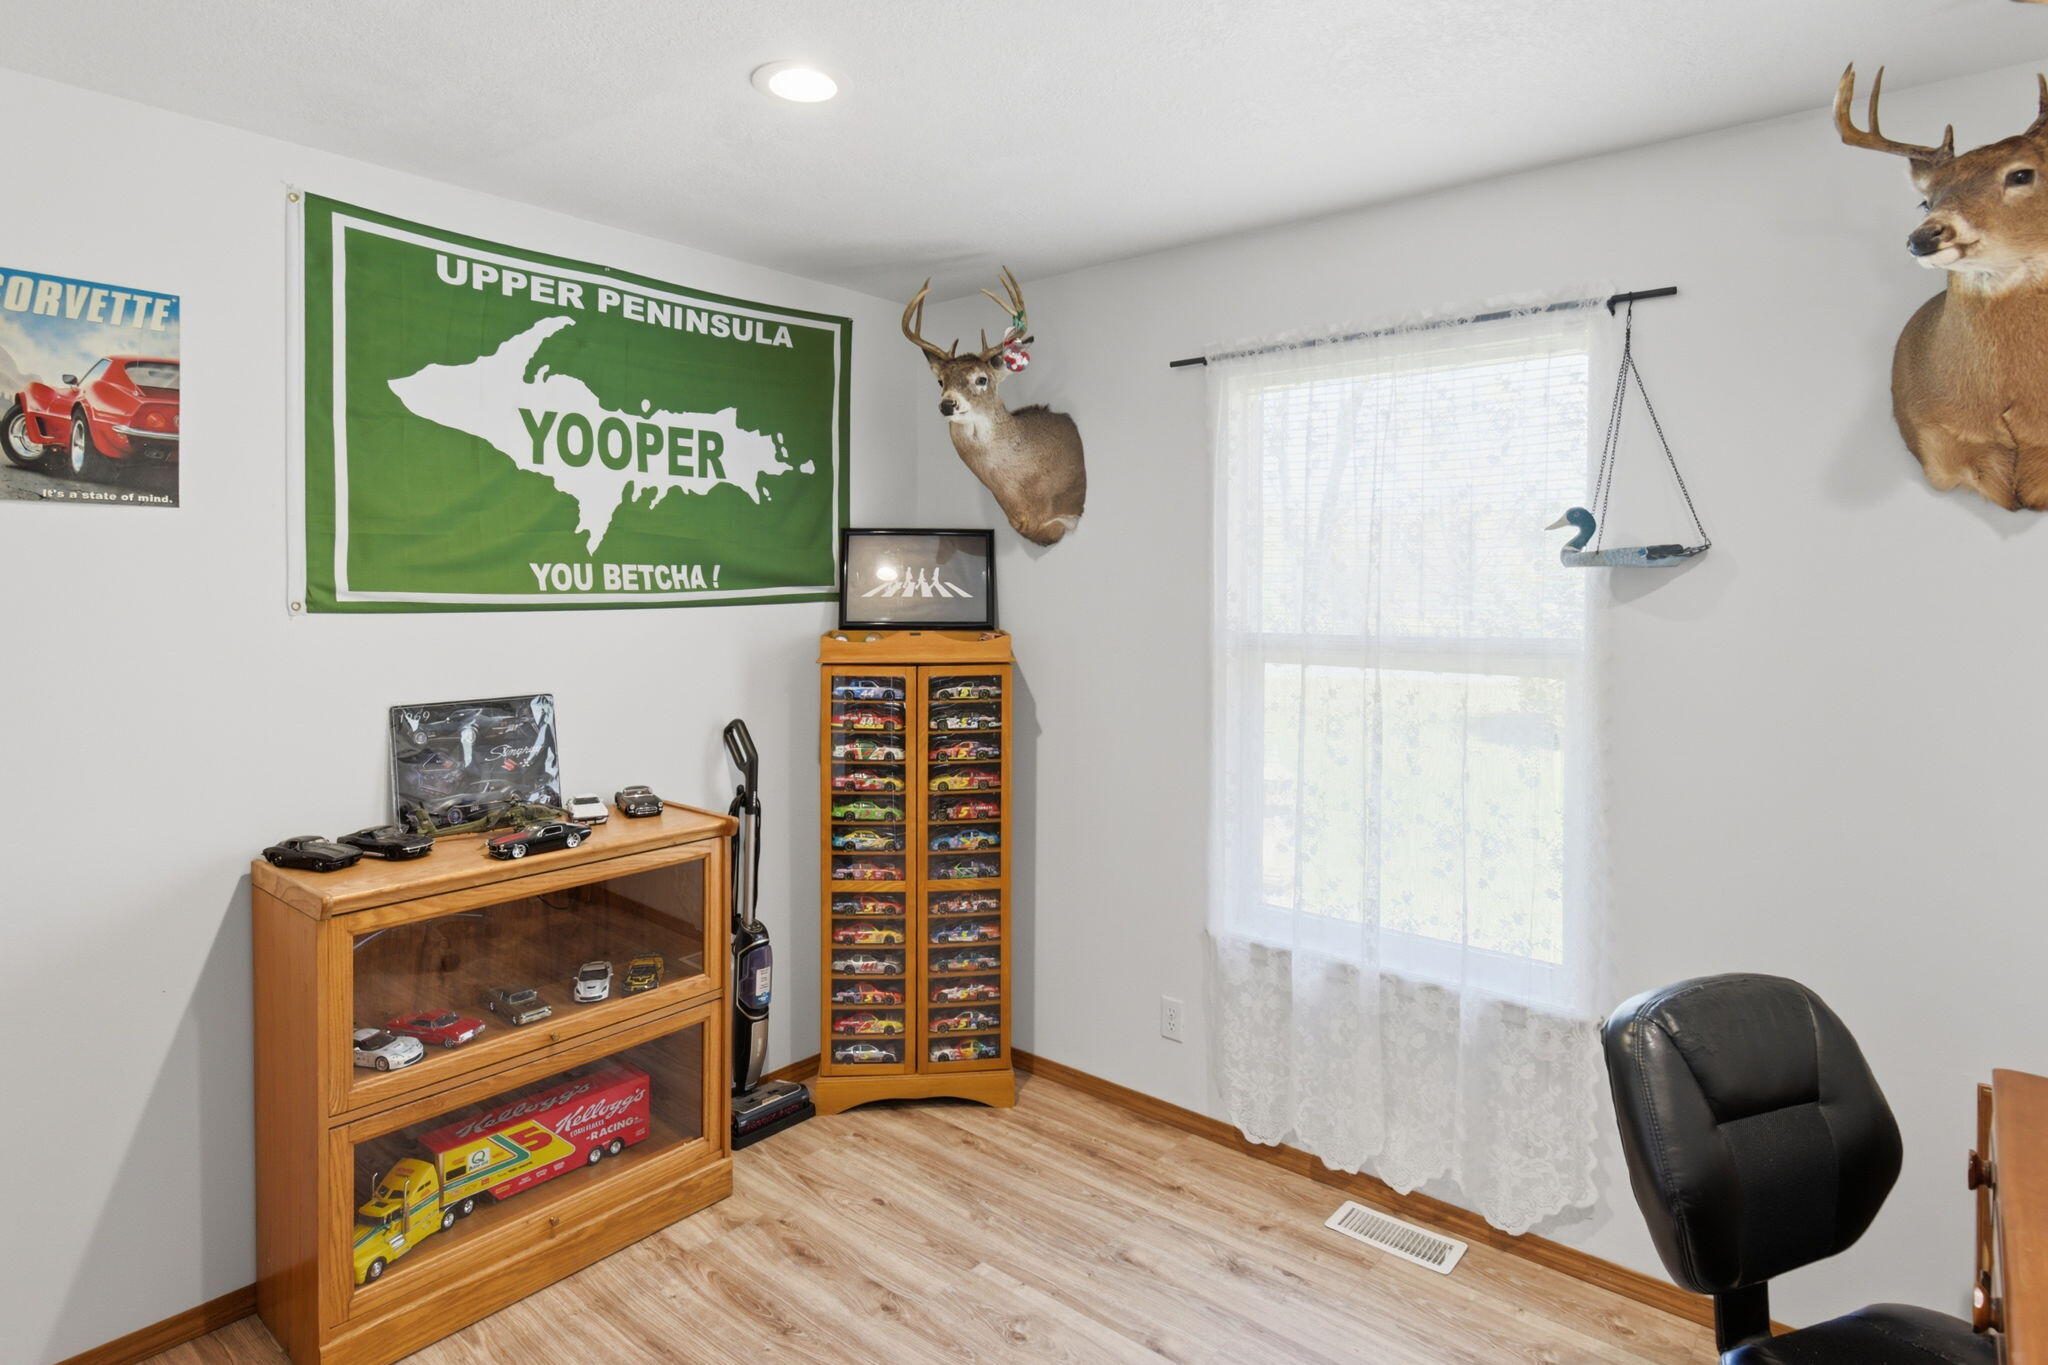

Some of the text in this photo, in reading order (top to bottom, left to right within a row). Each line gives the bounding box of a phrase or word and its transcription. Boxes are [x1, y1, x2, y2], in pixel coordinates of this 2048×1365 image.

[436, 253, 794, 349] UPPER PENINSULA
[518, 407, 727, 480] YOOPER
[42, 488, 174, 504] It's a state of mind.
[529, 562, 593, 592] YOU
[861, 689, 875, 698] 44
[958, 806, 970, 818] 5
[456, 1083, 590, 1138] Kellogg's
[555, 1088, 646, 1134] Kellogg's
[507, 1125, 553, 1151] 5
